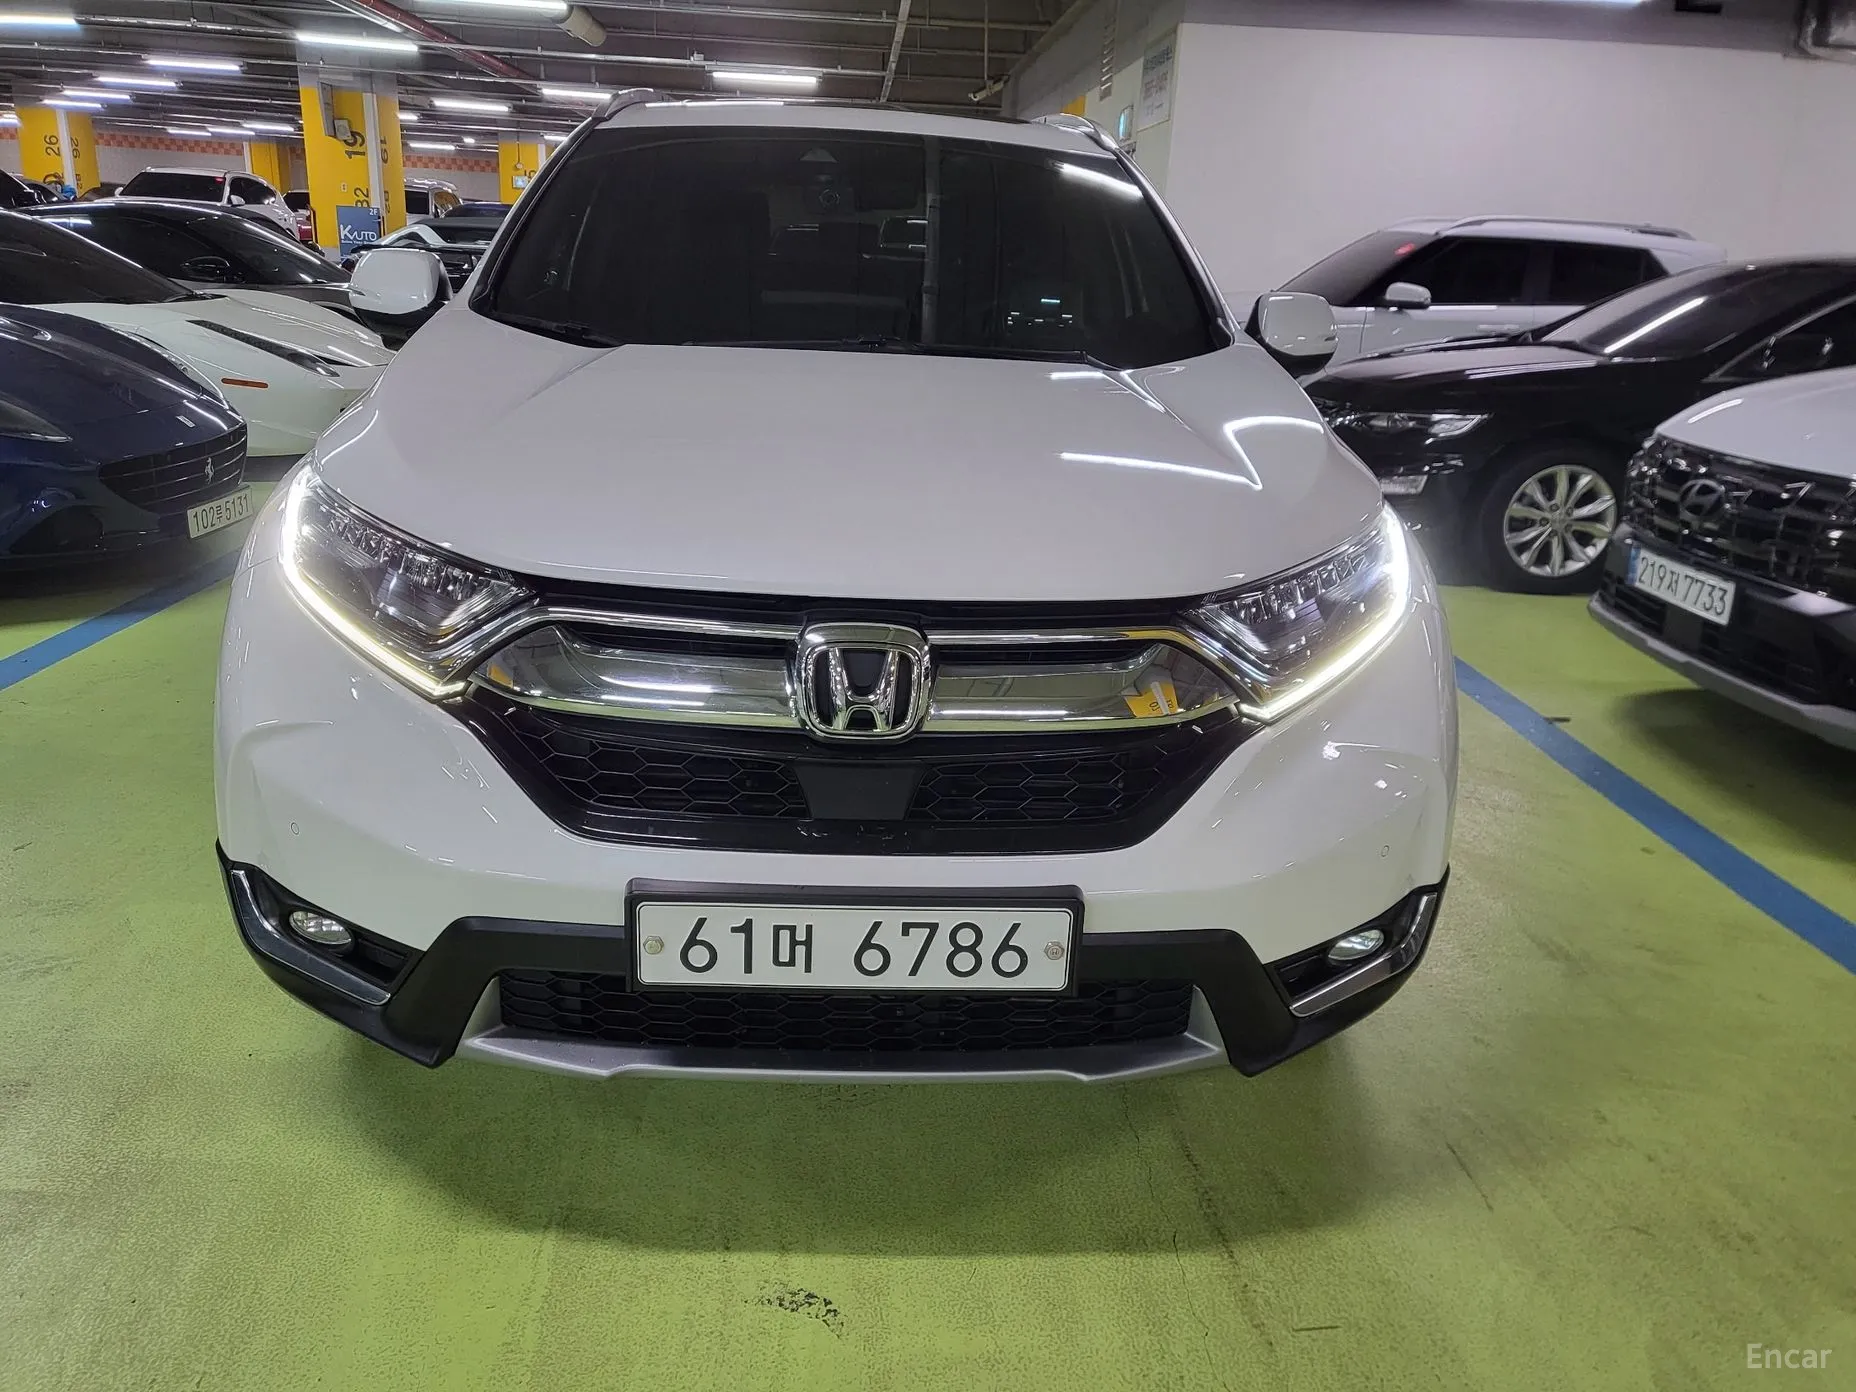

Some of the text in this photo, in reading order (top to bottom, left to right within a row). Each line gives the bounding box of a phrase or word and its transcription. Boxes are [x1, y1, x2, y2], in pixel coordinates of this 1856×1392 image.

[44, 135, 61, 157] 26
[369, 208, 378, 216] 2F
[679, 916, 1030, 978] 61머 6786
